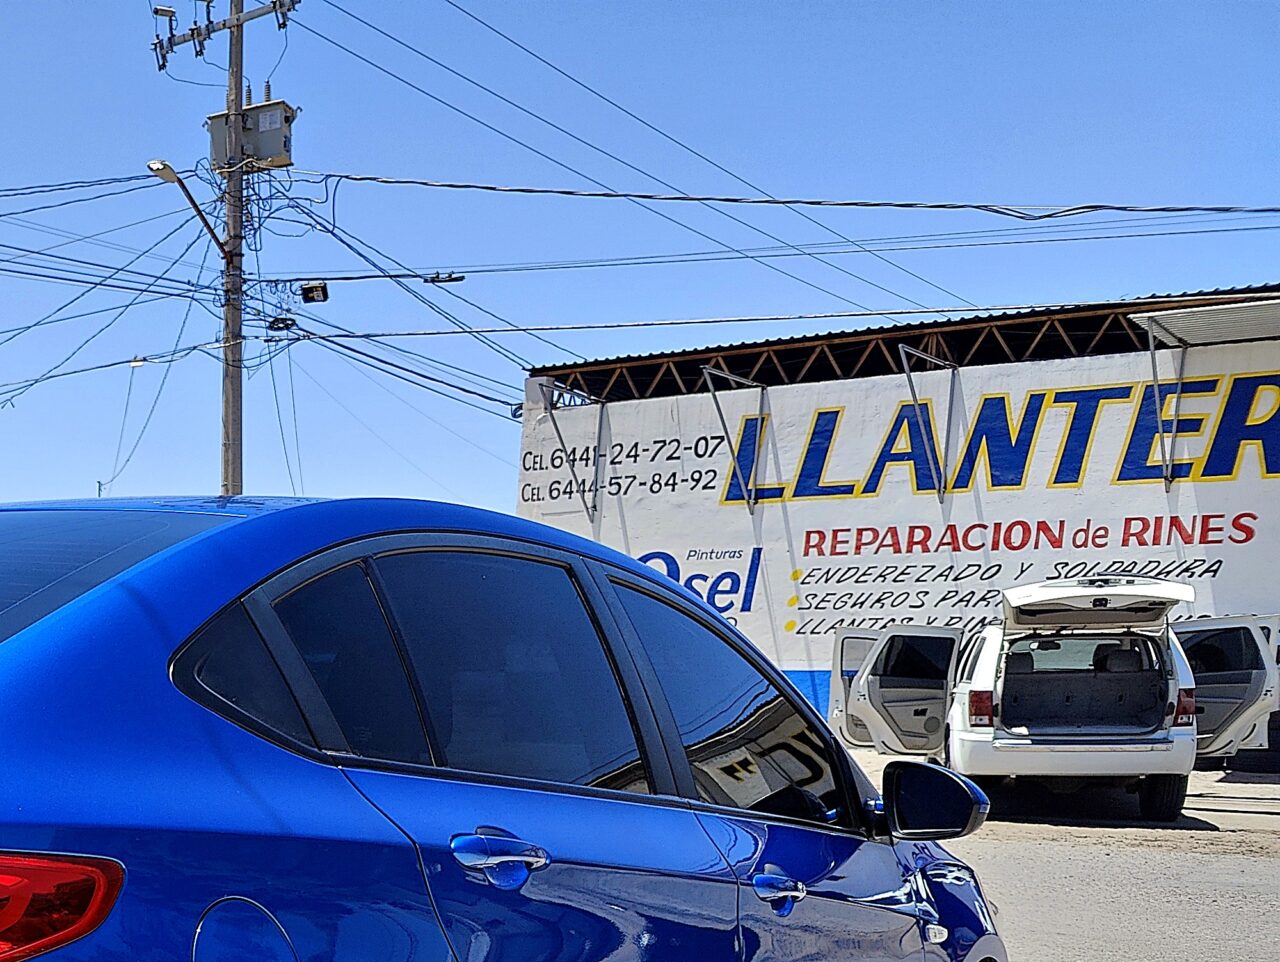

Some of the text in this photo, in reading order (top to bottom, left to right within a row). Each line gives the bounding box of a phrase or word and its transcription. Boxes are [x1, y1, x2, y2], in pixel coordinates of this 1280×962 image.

[720, 370, 1280, 506] LLANTER
[802, 512, 1259, 557] REPARACION de RINES
[686, 549, 743, 561] Pinturas
[800, 559, 1224, 585] ENDEREZADO Y SOLDADURA
[797, 590, 930, 611] SEGUROS
